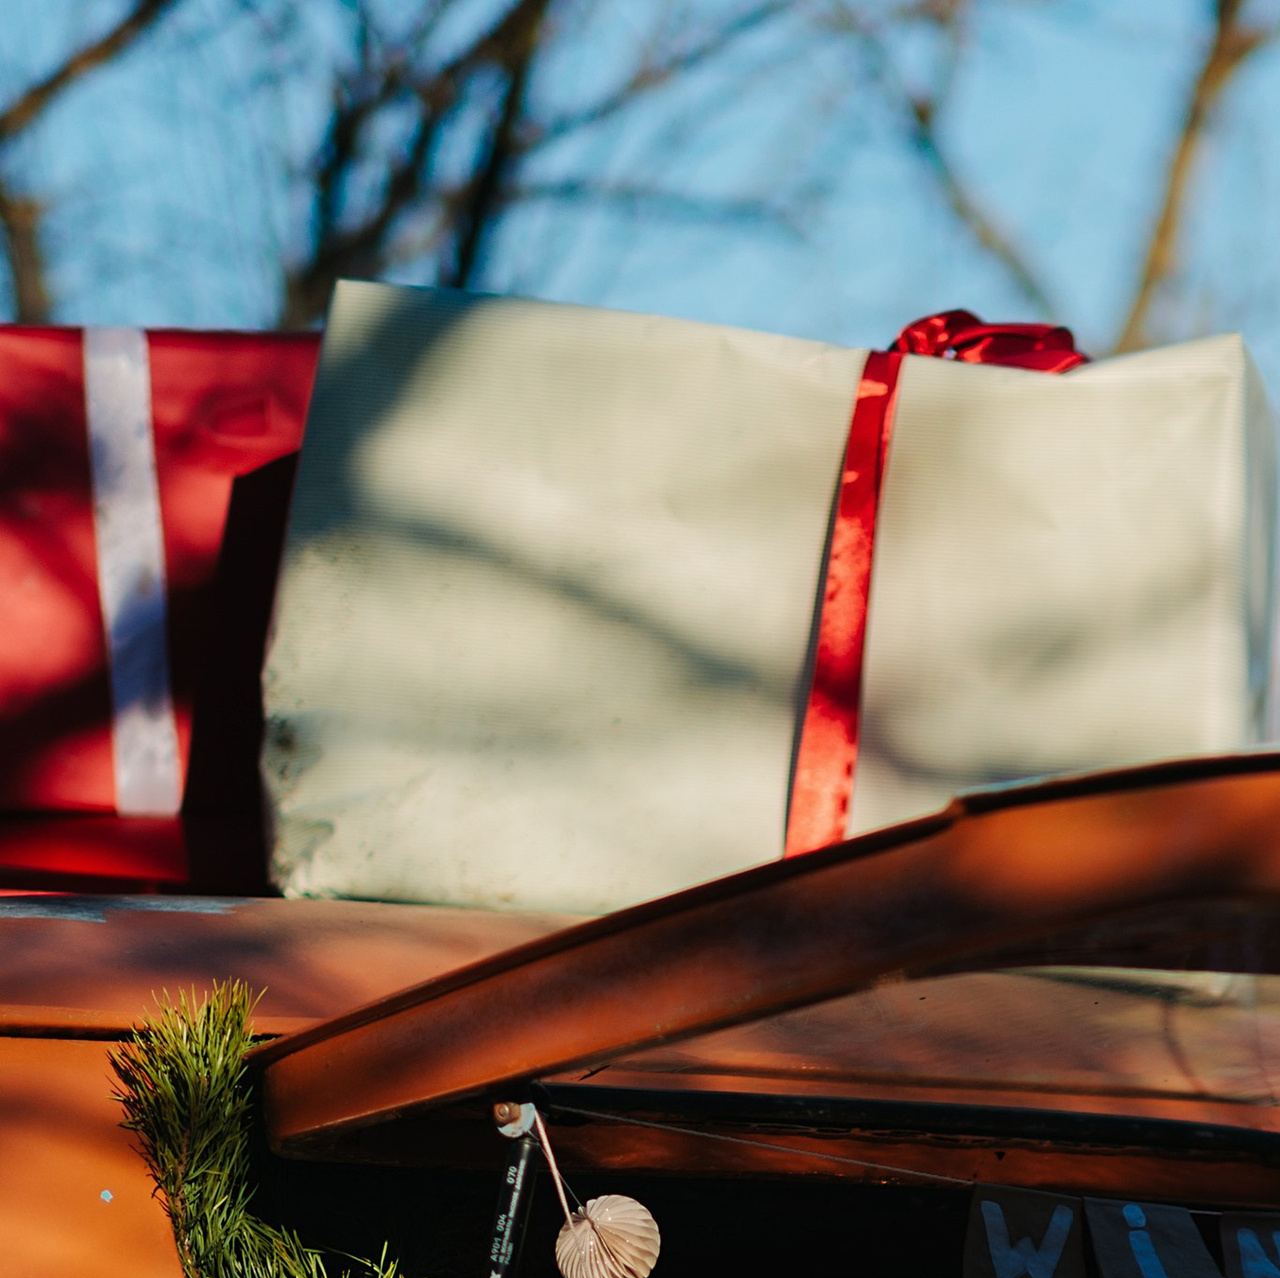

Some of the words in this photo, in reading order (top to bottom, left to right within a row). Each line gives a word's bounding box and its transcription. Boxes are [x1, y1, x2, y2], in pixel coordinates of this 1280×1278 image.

[490, 1237, 502, 1262] A901
[496, 1213, 507, 1232] 004
[506, 1165, 518, 1184] 070
